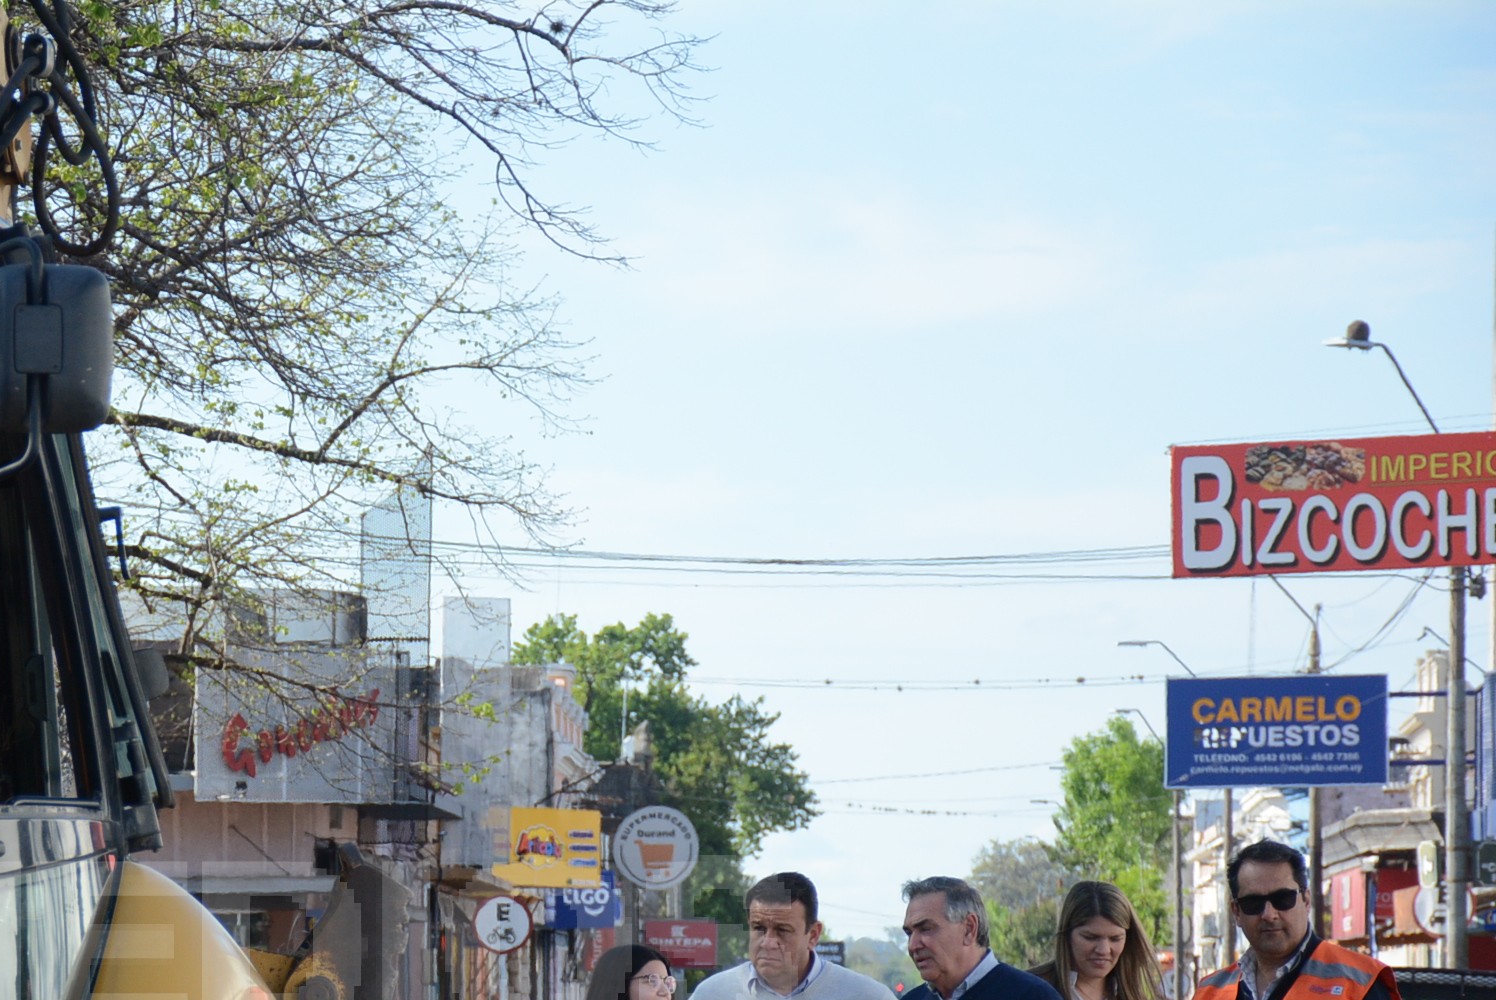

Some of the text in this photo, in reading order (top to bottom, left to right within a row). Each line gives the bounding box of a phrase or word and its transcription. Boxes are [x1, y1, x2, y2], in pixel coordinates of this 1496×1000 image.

[1192, 695, 1362, 724] CARMELO
[1194, 724, 1360, 748] REPUESTOS
[621, 811, 692, 840] SUPERMERCADO
[636, 828, 676, 837] Durand
[496, 903, 511, 921] E
